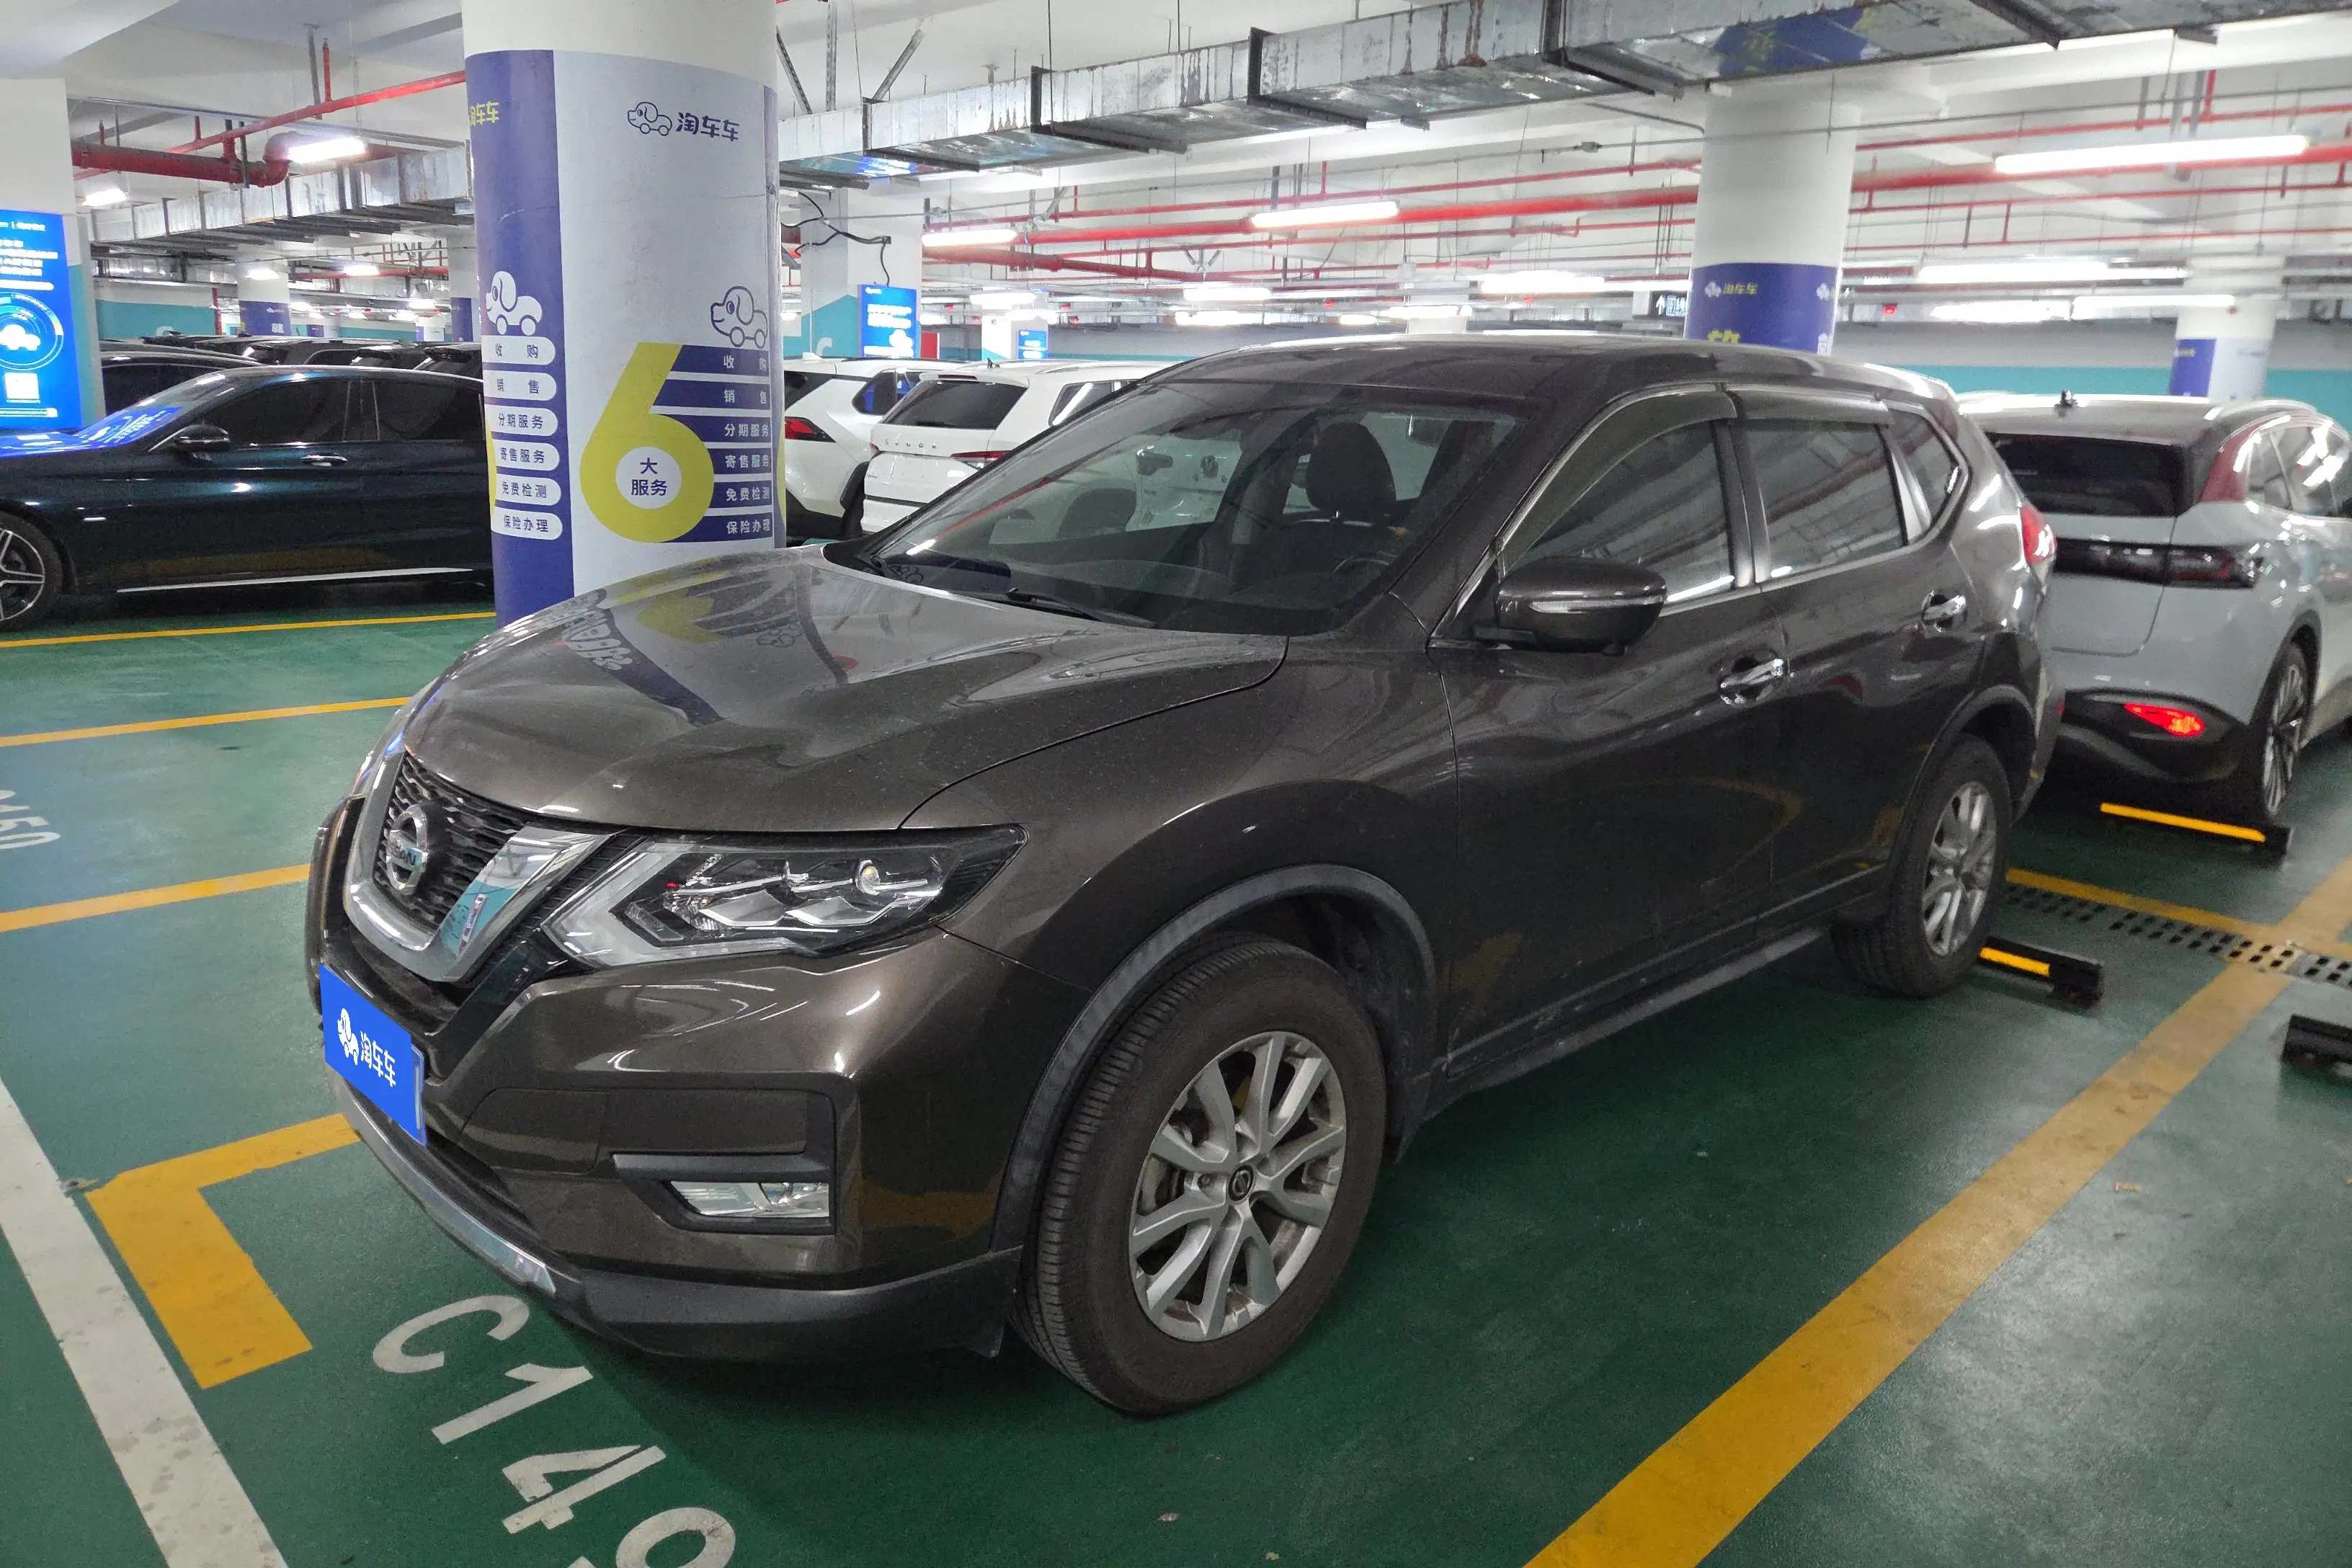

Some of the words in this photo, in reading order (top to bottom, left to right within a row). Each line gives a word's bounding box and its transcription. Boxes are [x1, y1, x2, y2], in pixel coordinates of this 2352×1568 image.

[676, 112, 739, 142] 淘车车
[498, 413, 543, 429] 分期服务
[724, 423, 770, 437] 分期服务
[579, 342, 714, 543] 6
[500, 447, 545, 463] 寄售服务
[725, 454, 770, 468] 寄售服务
[640, 458, 658, 474] 大
[502, 481, 547, 498] 免费检测
[631, 479, 667, 496] 服务
[726, 486, 770, 502] 免费检测
[504, 514, 548, 532] 保险办理
[726, 519, 770, 534] 保险办理
